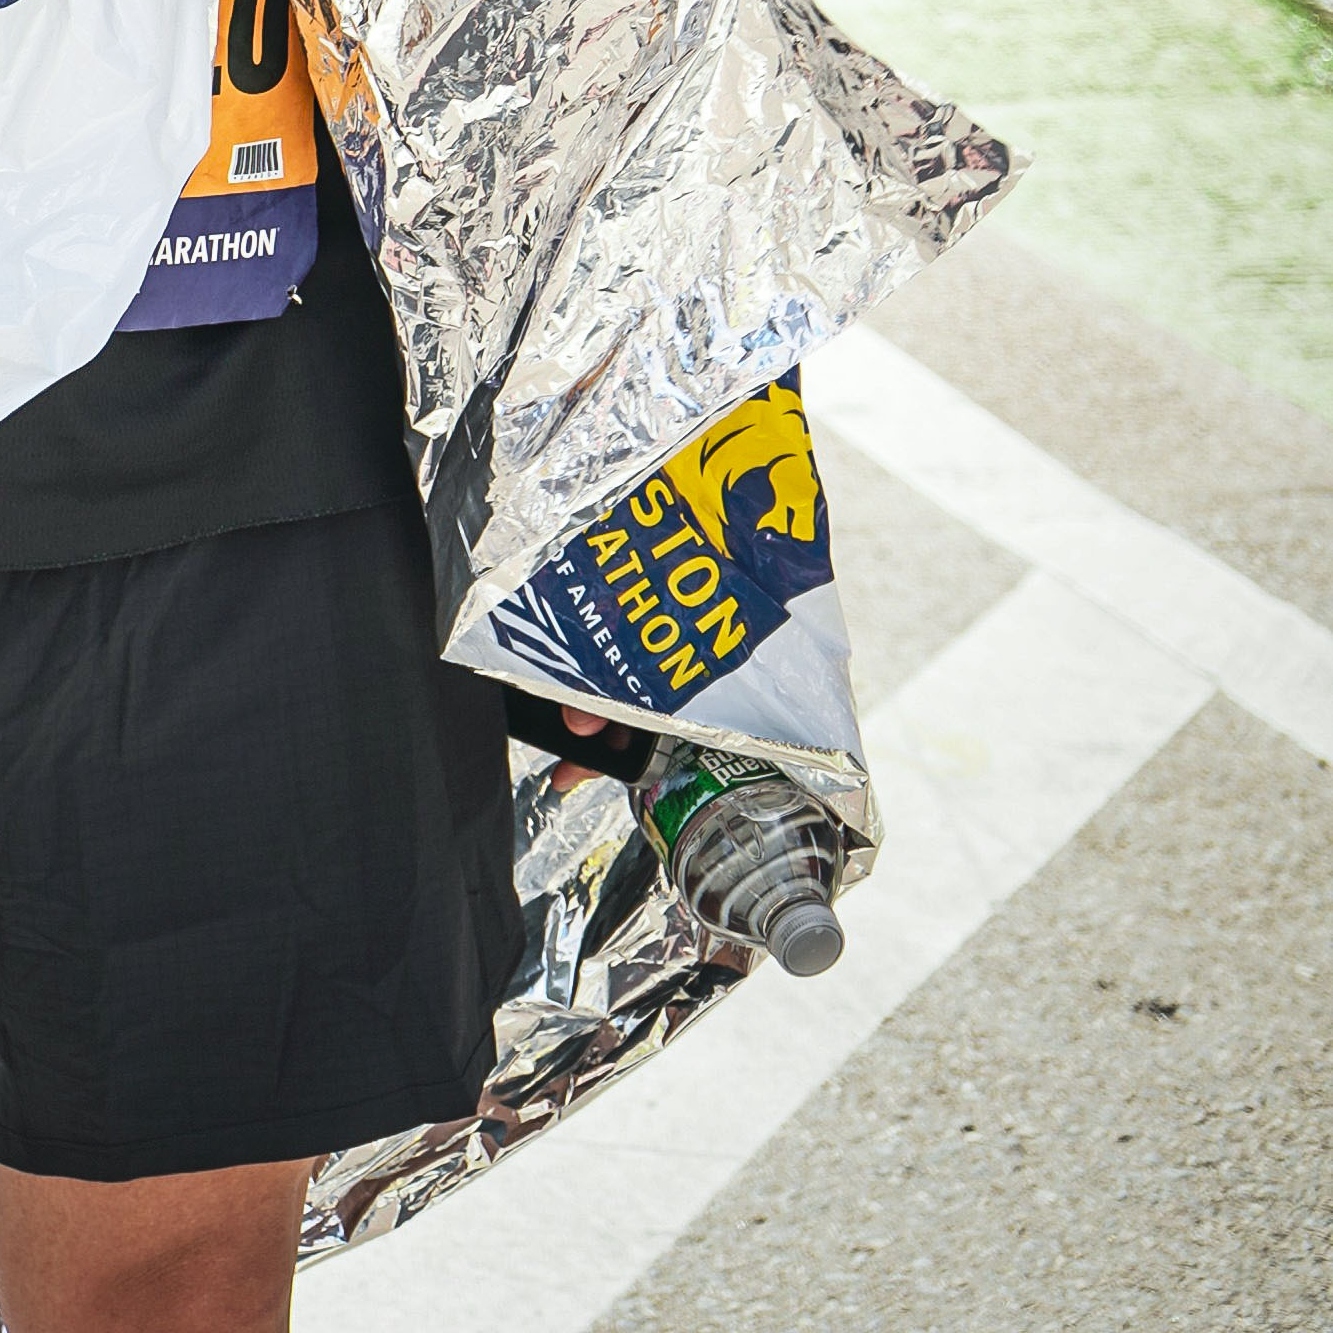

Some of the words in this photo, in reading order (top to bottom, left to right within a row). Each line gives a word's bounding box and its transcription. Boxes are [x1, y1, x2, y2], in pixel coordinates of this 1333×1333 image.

[148, 227, 278, 266] ARATHON
[586, 523, 707, 692] ATHON
[629, 478, 747, 660] STON
[566, 584, 655, 710] AMERICA
